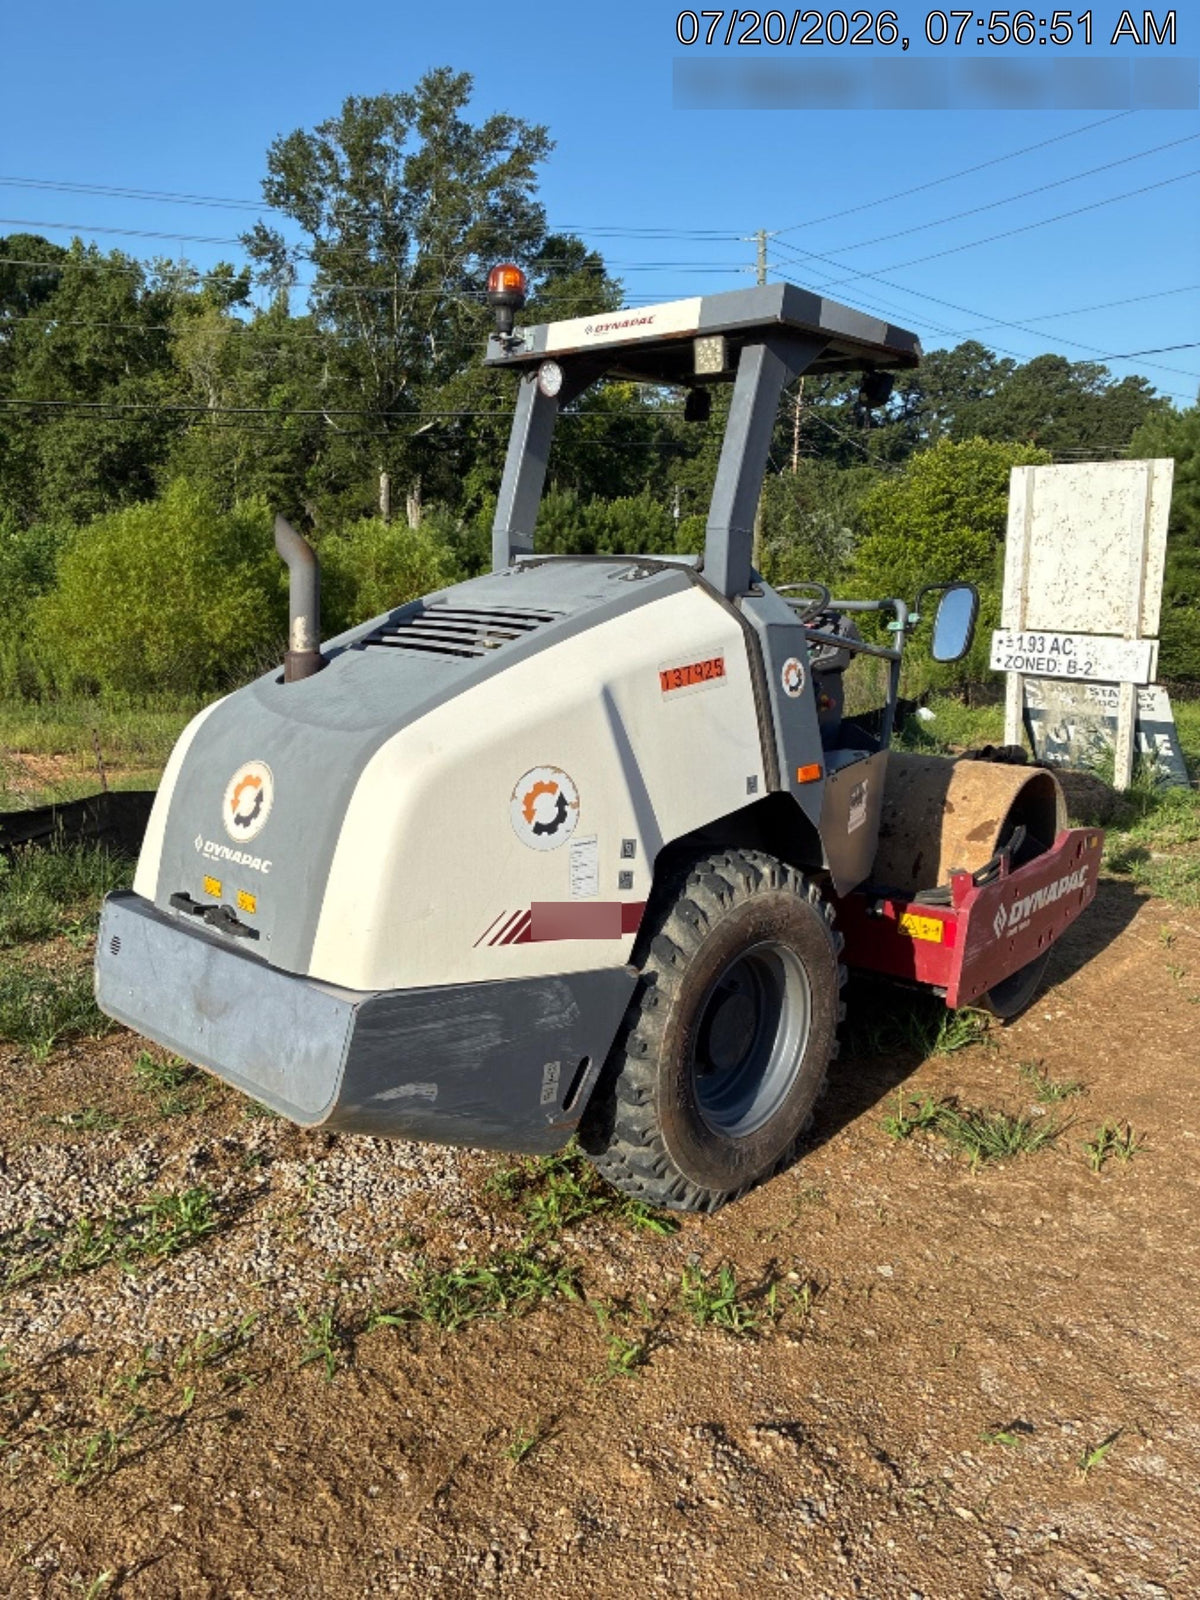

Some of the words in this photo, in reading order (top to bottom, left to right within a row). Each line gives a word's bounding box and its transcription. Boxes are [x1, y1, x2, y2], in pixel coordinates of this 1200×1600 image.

[595, 315, 656, 333] DYNAPAC
[662, 658, 723, 691] 137925
[1004, 655, 1061, 673] ZONED:
[1066, 659, 1093, 676] B-2
[204, 840, 273, 874] DYNAPAC
[1008, 864, 1089, 927] DYNAPAC
